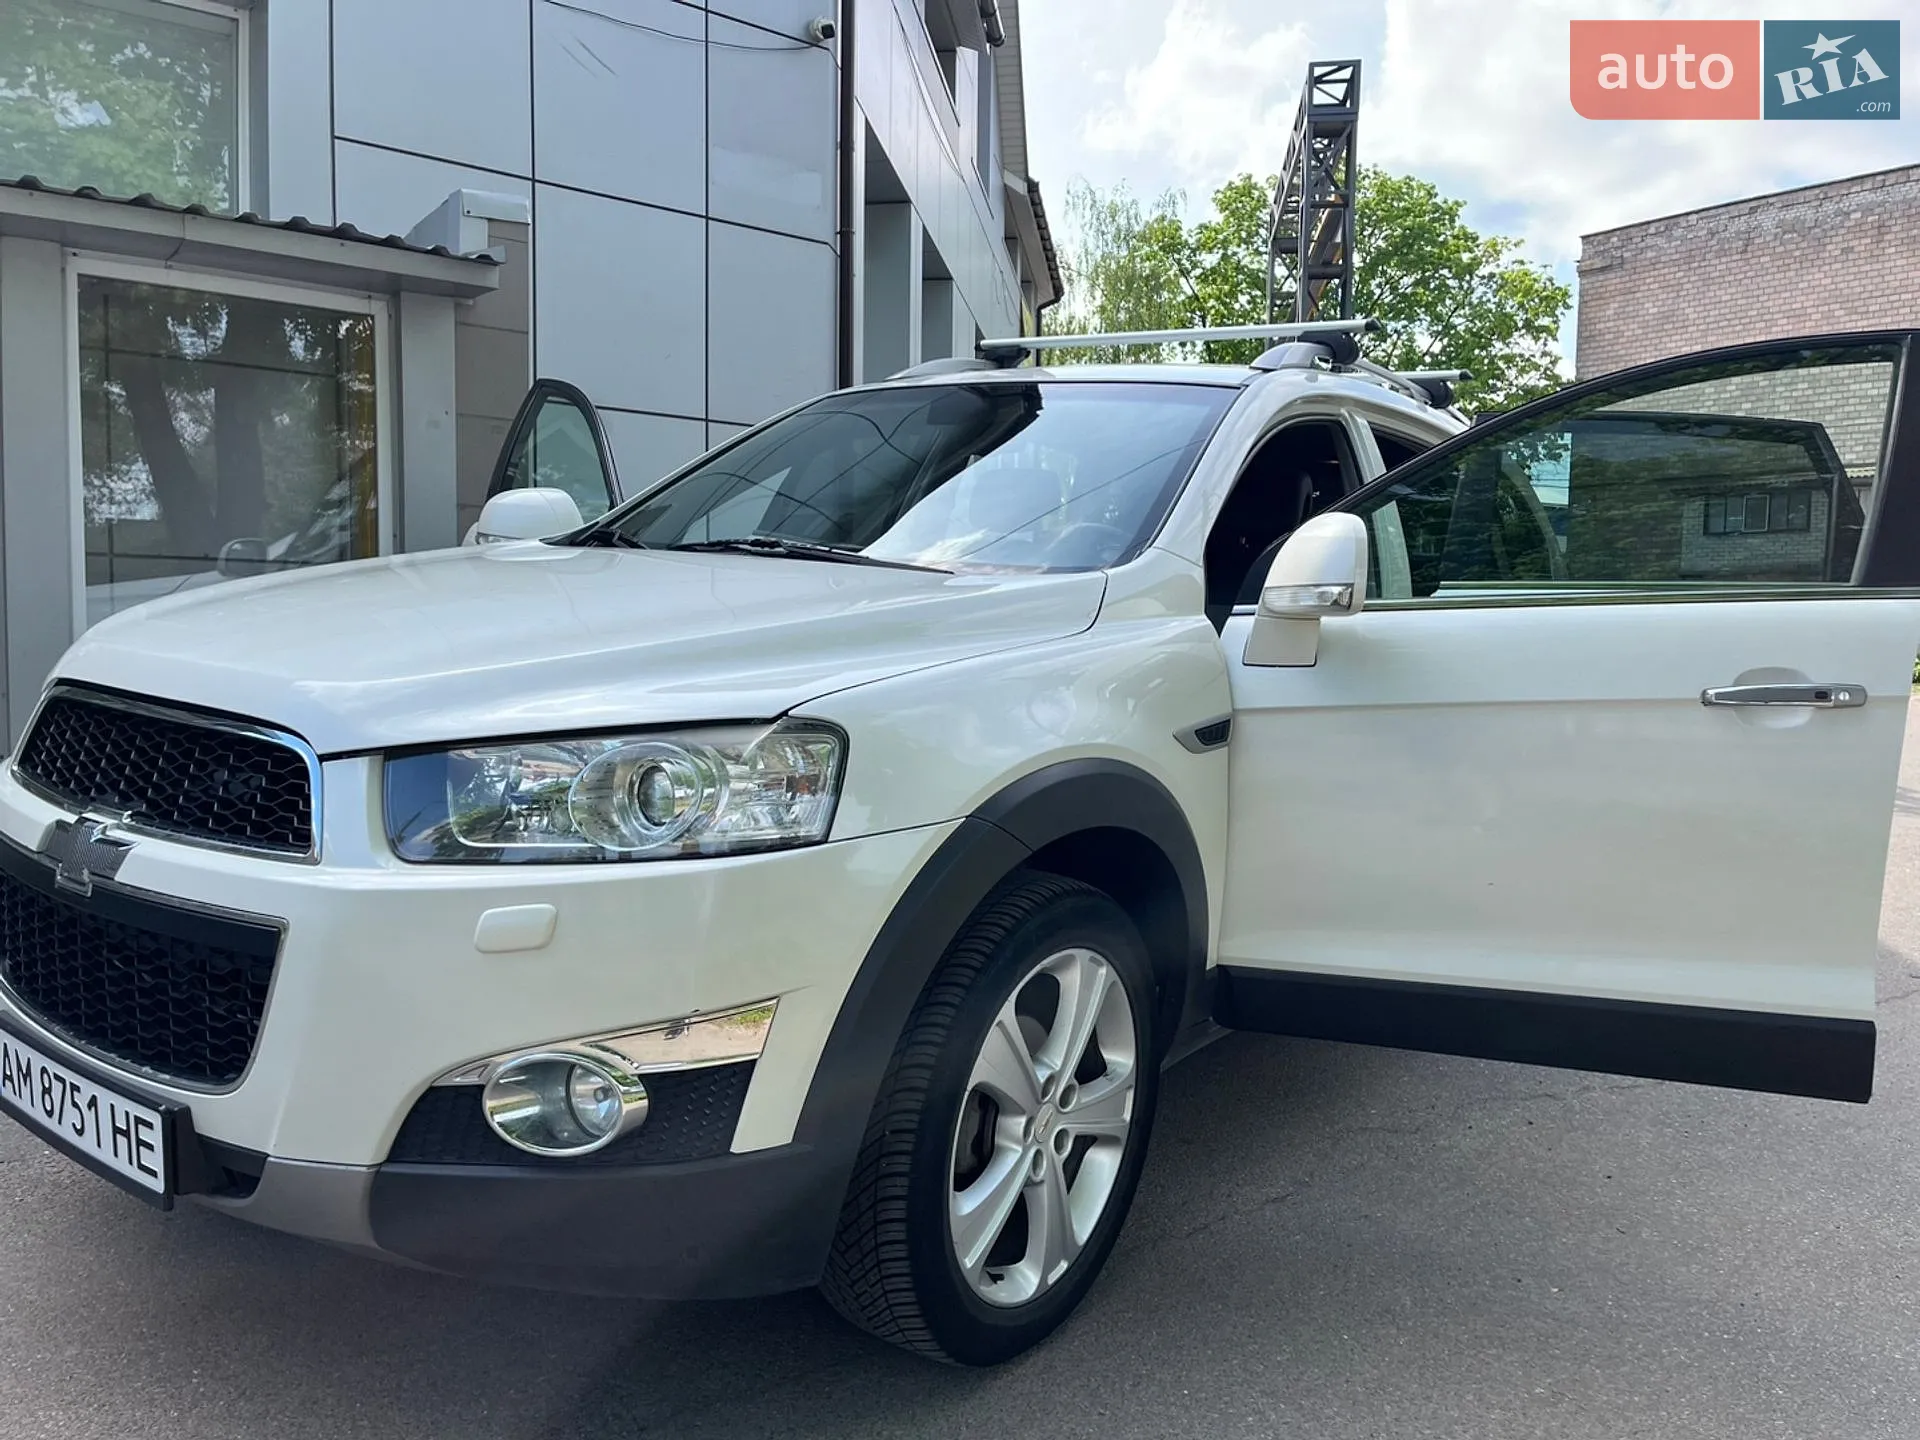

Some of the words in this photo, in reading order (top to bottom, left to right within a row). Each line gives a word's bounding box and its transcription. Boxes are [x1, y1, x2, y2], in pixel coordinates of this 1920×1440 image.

[2, 1042, 35, 1108] AM
[40, 1065, 102, 1149] 8751
[110, 1102, 158, 1179] HE
